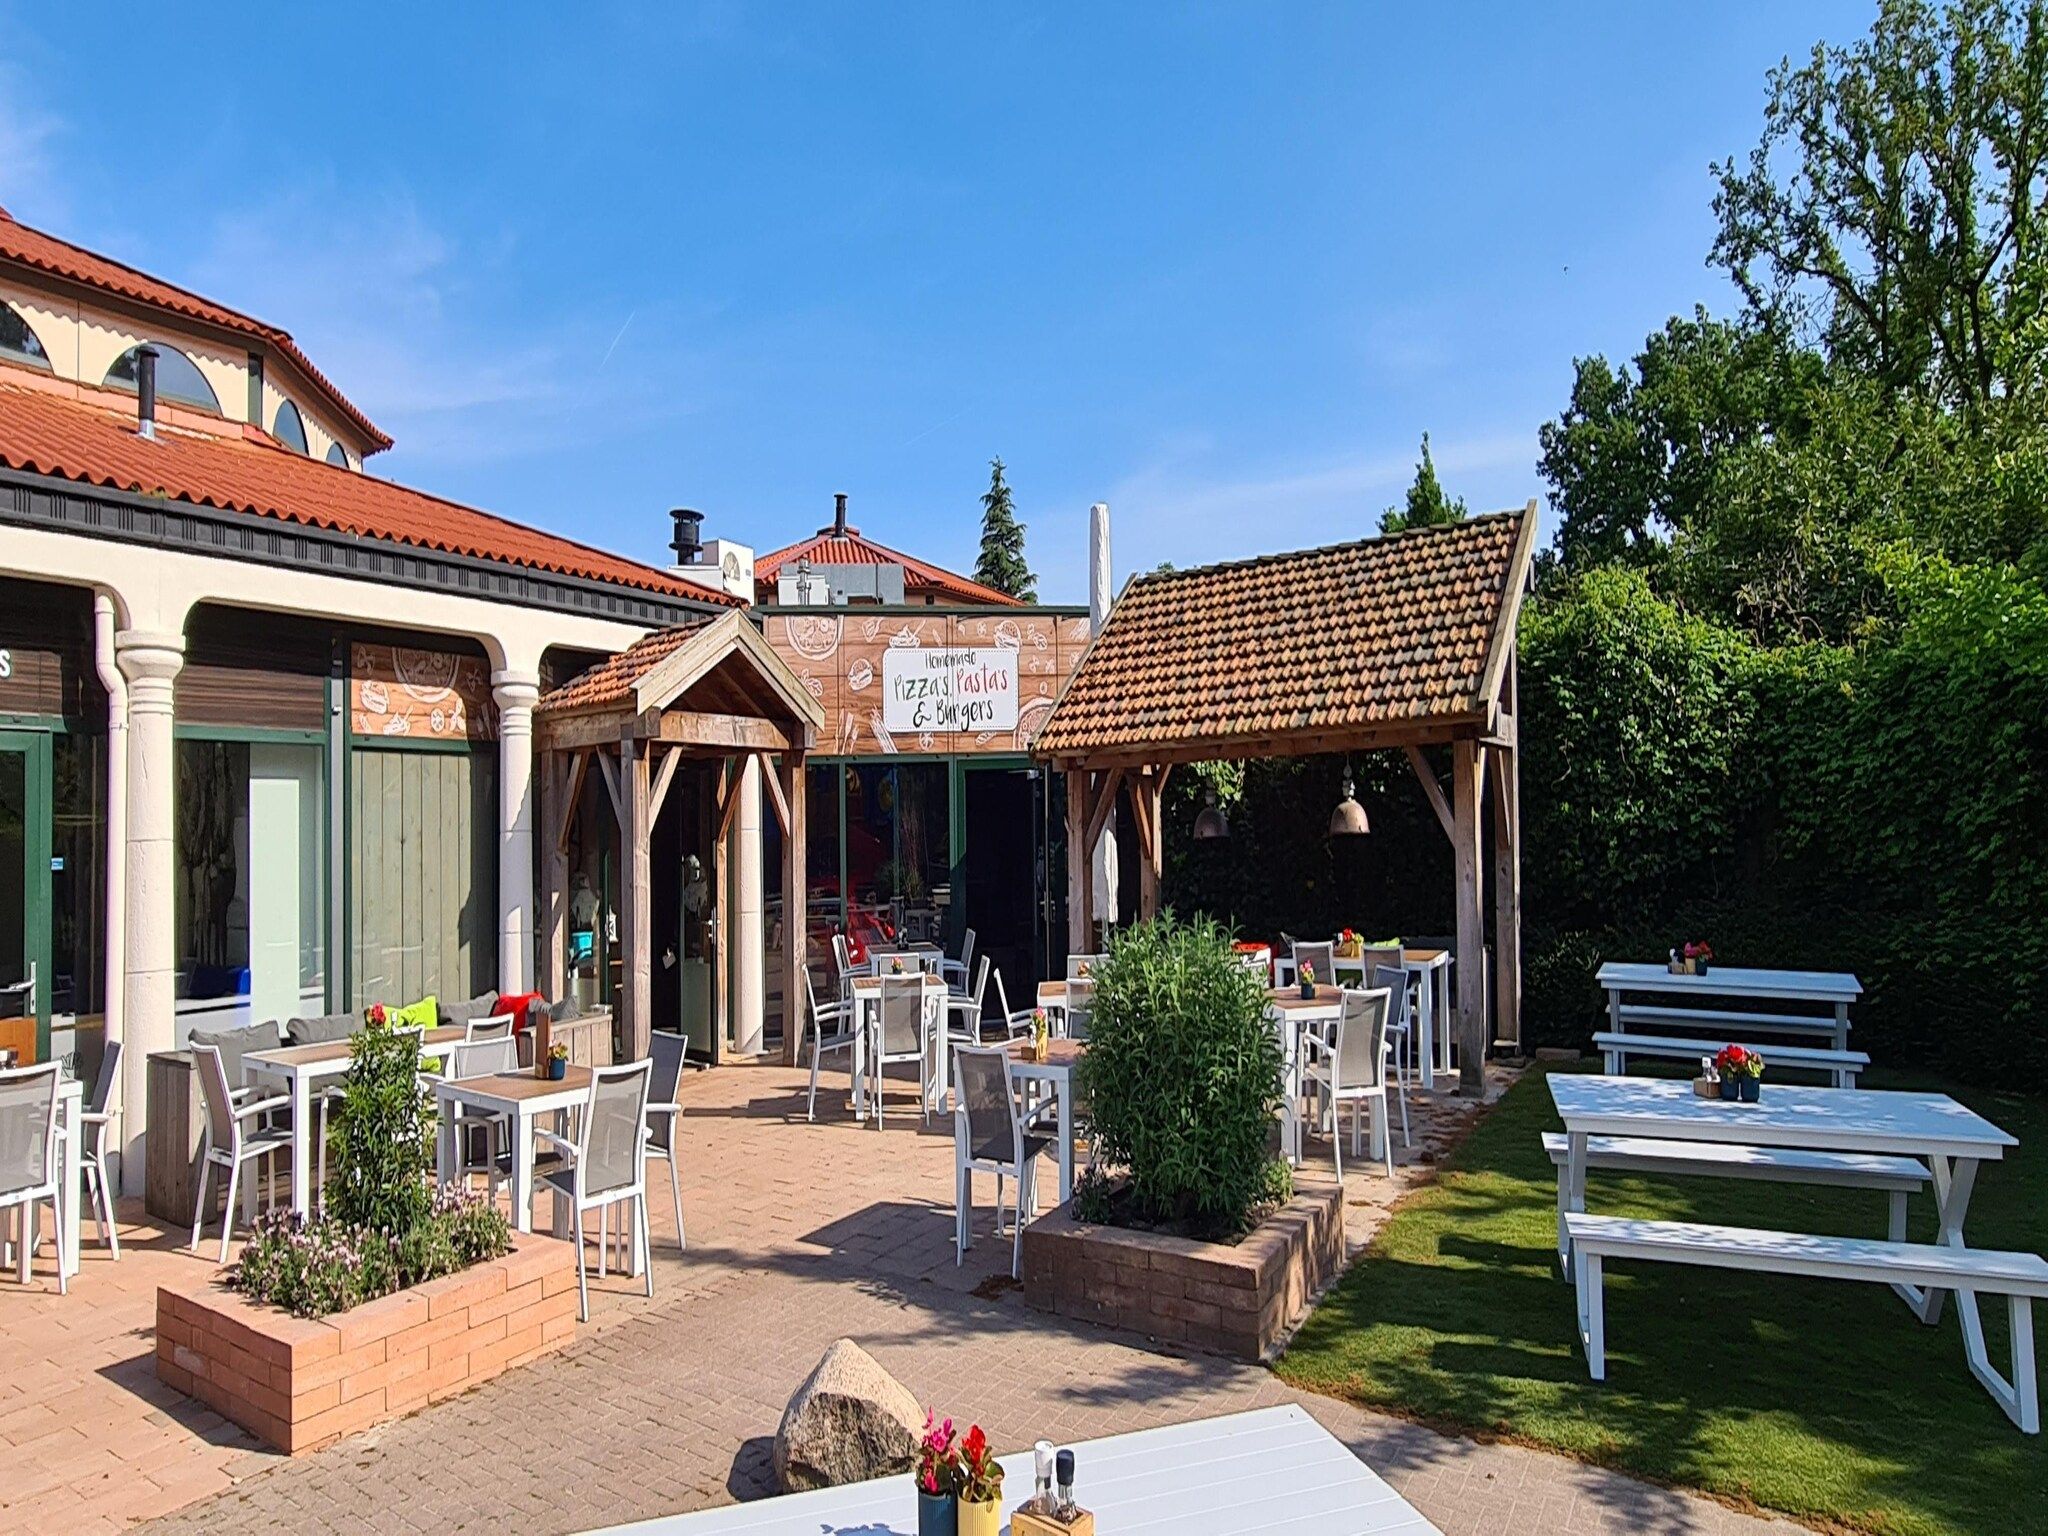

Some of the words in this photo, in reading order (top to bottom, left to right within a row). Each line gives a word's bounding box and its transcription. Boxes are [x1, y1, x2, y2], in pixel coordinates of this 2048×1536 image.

[956, 662, 1008, 694] Pasta's
[912, 701, 932, 728] &
[936, 698, 993, 732] Burgers
